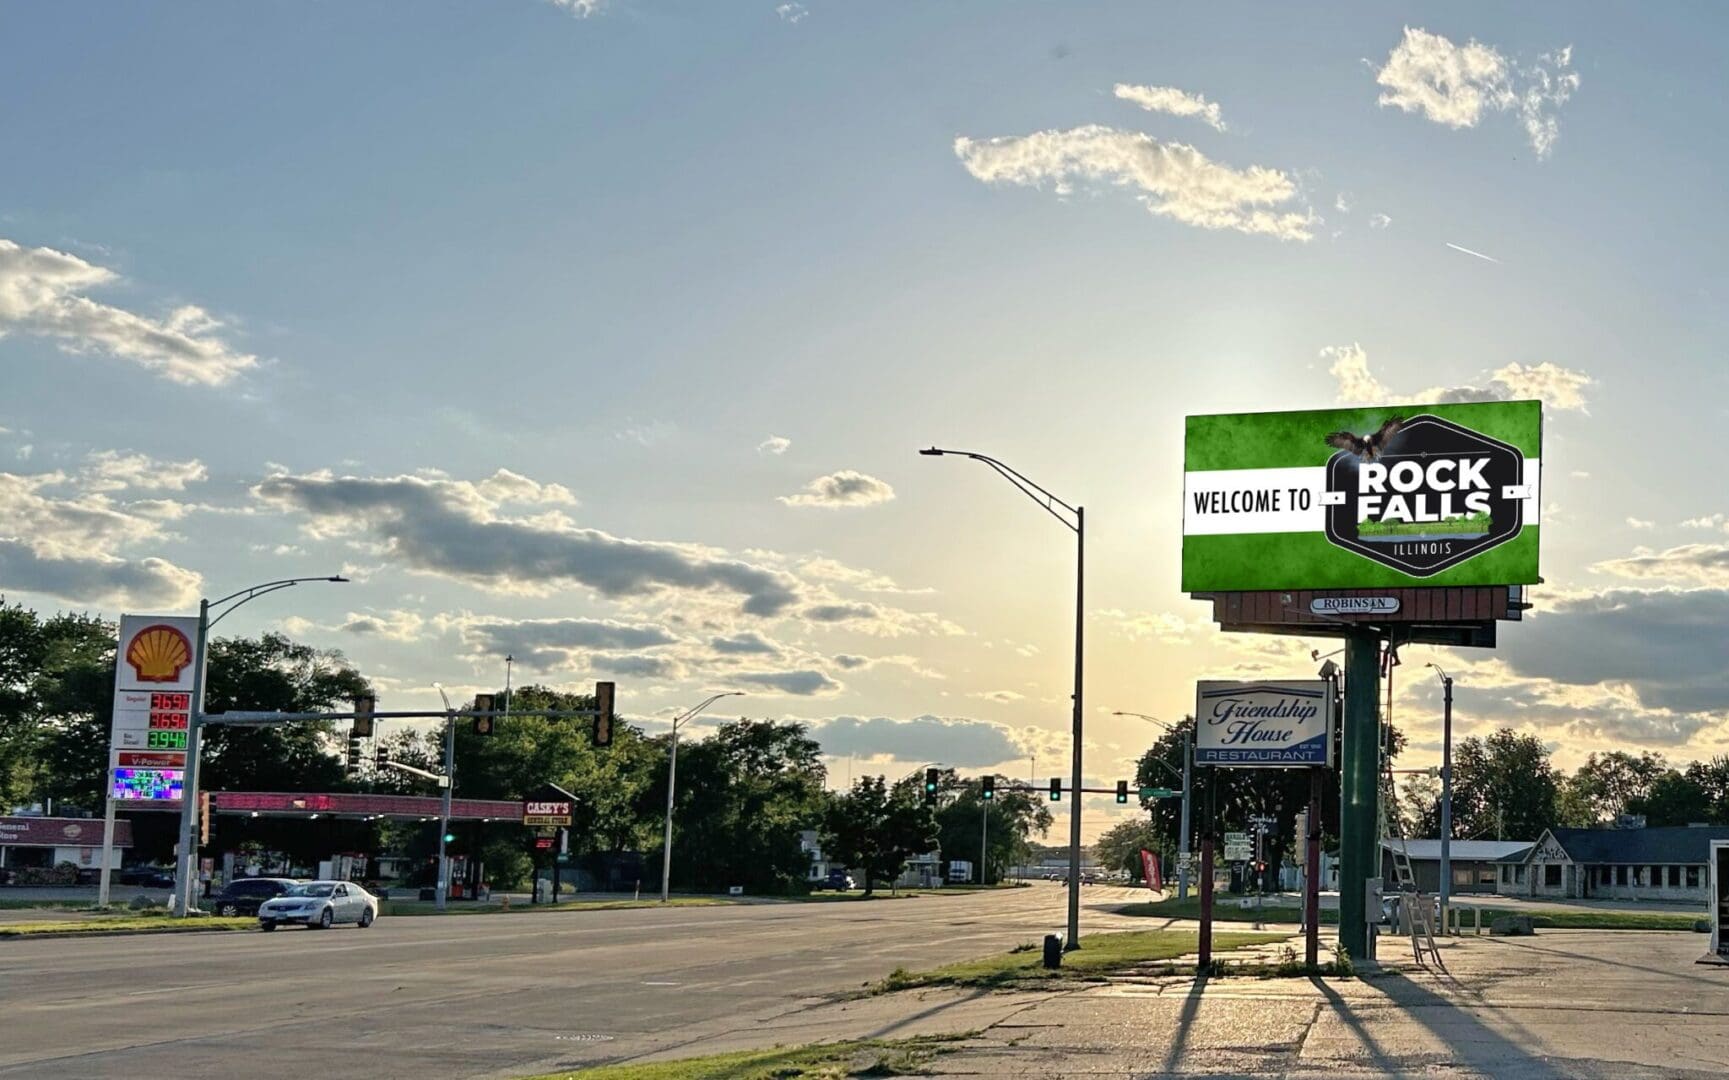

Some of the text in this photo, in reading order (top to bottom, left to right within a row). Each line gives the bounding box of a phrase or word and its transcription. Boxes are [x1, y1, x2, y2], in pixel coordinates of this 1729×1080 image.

[1358, 458, 1491, 494] ROCK
[1193, 488, 1310, 515] WELCOME TO
[1357, 491, 1491, 523] FALLS
[1393, 542, 1452, 556] ILLINOIS
[1208, 699, 1317, 725] Friendship
[1221, 720, 1293, 744] House
[132, 758, 170, 766] V-Power
[1206, 751, 1316, 760] RESTAURANT
[527, 802, 569, 814] CASEY'S
[0, 822, 30, 831] eneral
